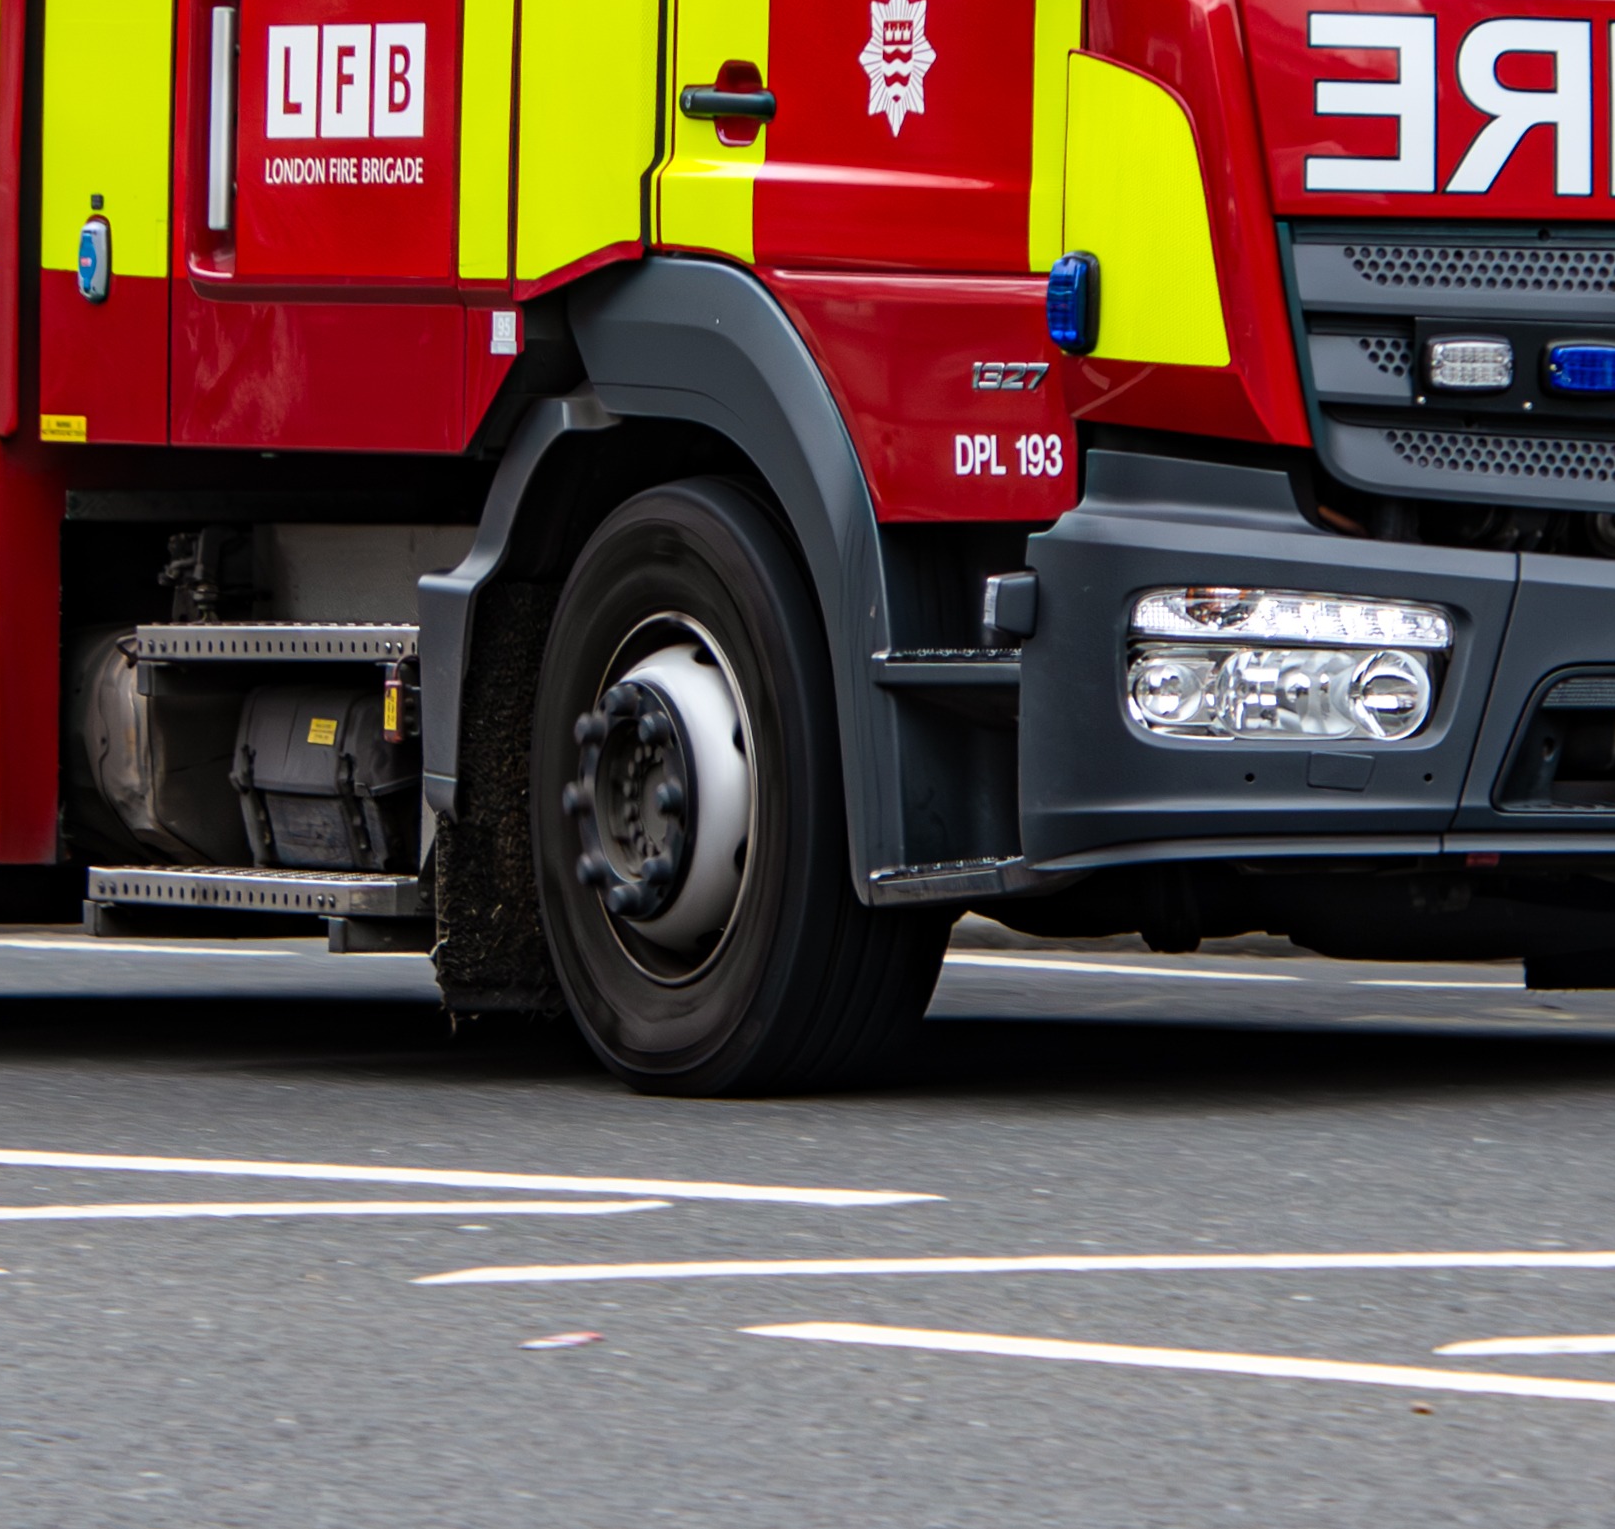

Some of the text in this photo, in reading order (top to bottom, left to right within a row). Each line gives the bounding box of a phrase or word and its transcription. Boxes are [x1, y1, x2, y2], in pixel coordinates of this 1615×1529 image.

[279, 42, 415, 117] LFB
[265, 156, 424, 185] LONDON FIRE BRIGADE
[971, 361, 1050, 391] 1327
[954, 433, 1064, 477] DPL 193
